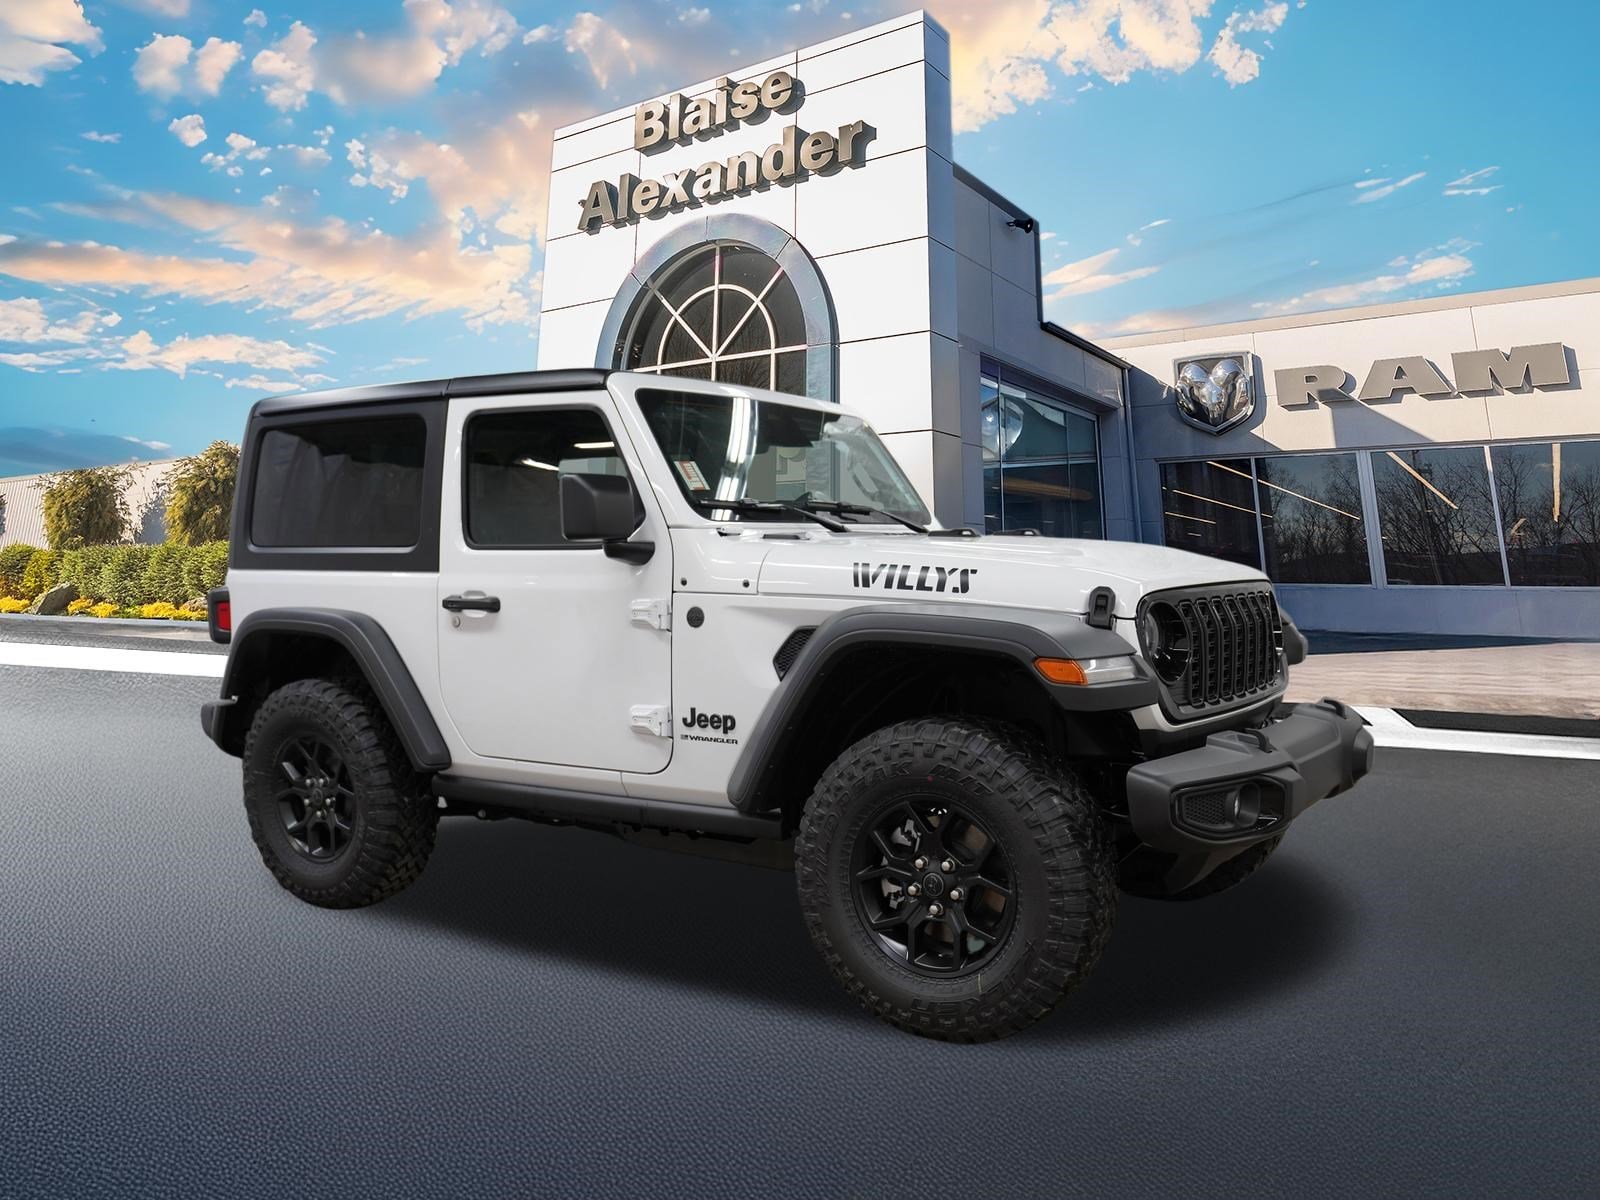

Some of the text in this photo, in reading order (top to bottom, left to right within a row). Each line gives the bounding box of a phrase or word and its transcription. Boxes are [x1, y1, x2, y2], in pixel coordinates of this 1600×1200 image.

[633, 70, 798, 152] Blaise
[577, 119, 867, 232] Alexander
[1274, 342, 1571, 406] RAM
[853, 562, 978, 593] WILLYS
[682, 707, 736, 734] Jeep
[689, 734, 738, 744] WRANGLER
